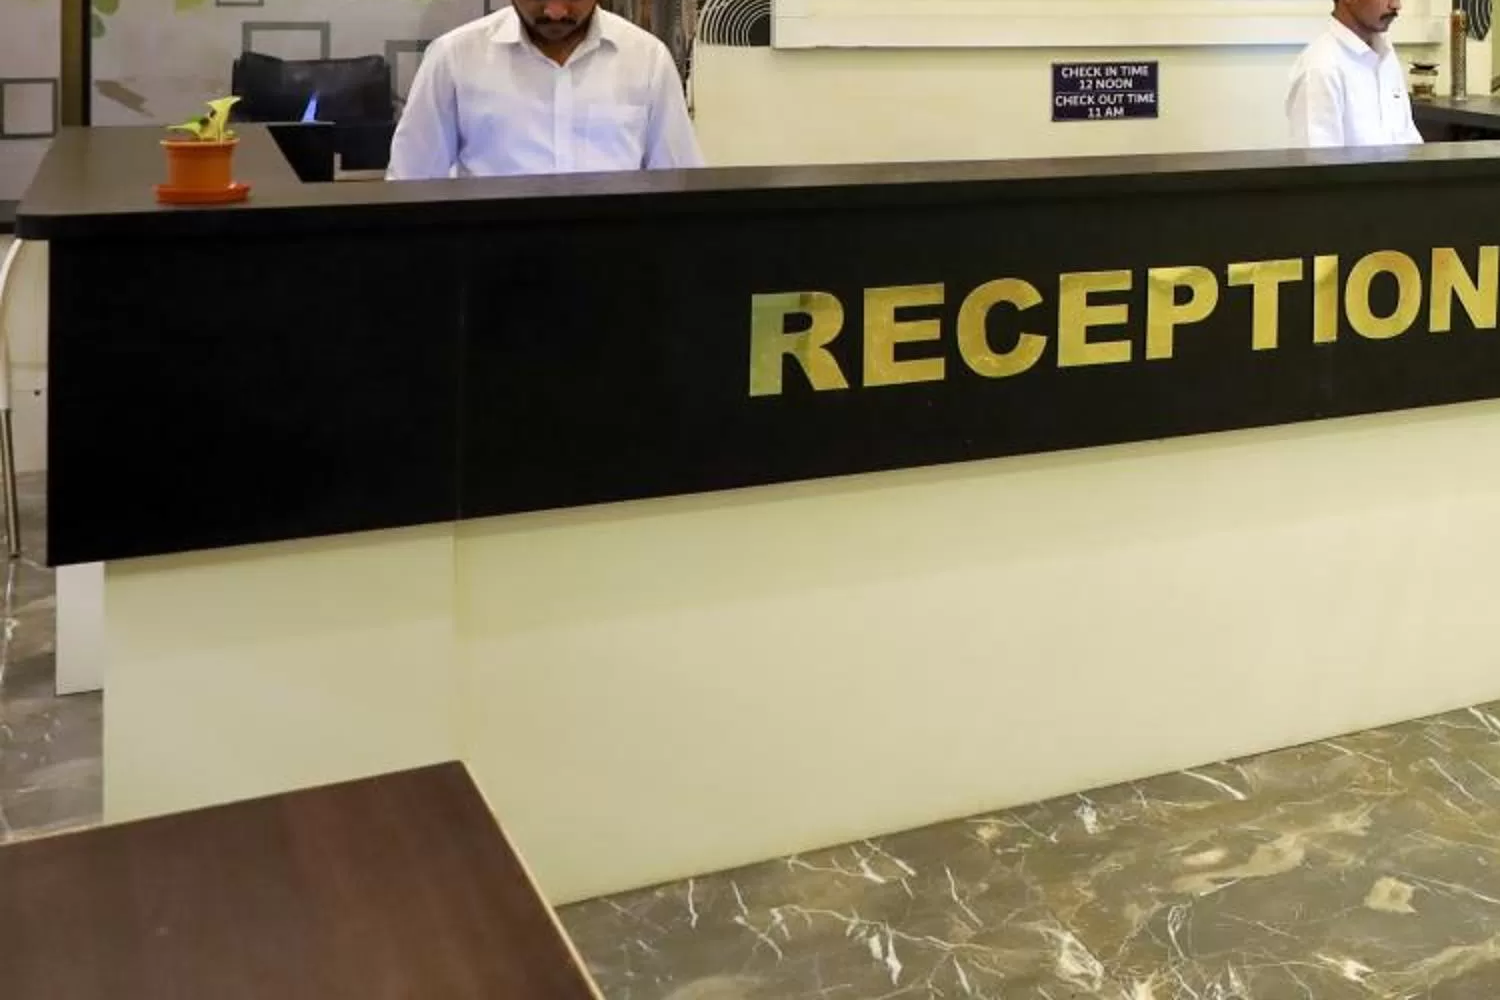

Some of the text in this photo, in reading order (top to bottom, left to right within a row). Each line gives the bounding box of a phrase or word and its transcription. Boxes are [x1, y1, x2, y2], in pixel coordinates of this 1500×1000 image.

[1061, 65, 1149, 78] CHECK IN TIME
[1079, 78, 1133, 89] 12 NOON
[1055, 93, 1155, 106] CHECK OUT TIME
[1088, 106, 1124, 117] 11 AM
[749, 245, 1500, 396] RECEPTION
